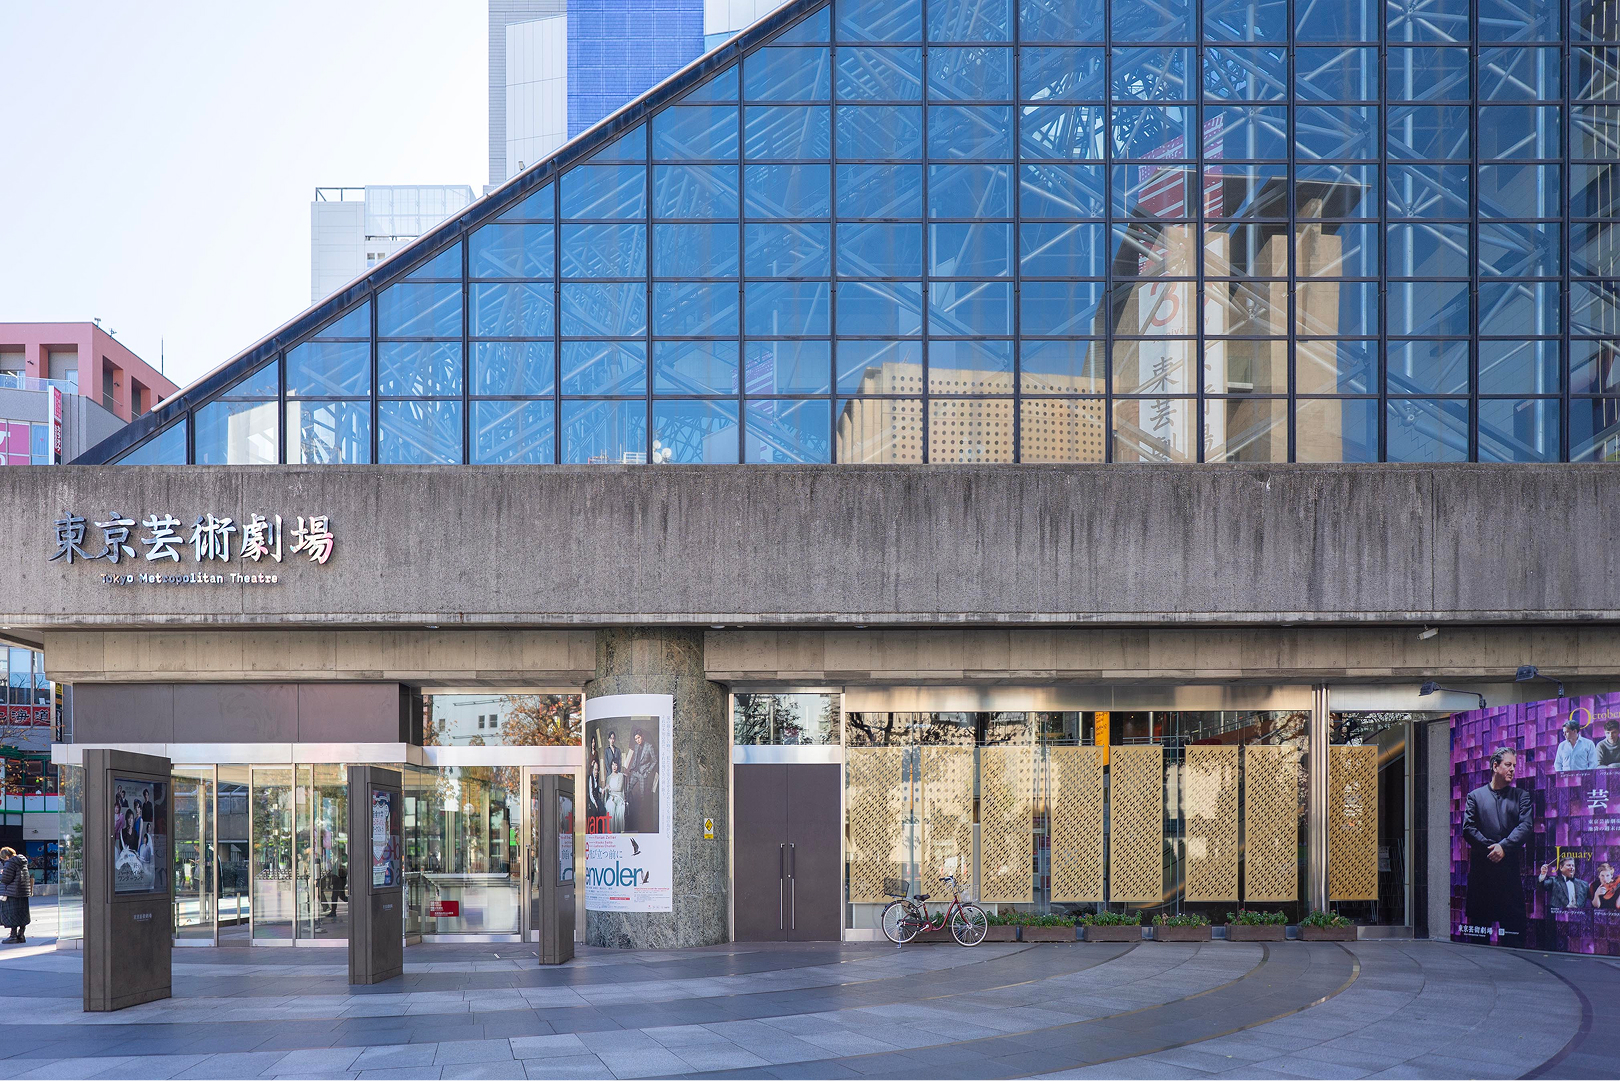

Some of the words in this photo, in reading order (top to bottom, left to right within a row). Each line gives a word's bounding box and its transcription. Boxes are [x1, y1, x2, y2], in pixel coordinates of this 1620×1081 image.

[48, 510, 335, 565] 東京芸術劇場
[101, 573, 134, 585] Tokyo
[139, 572, 224, 585] Metropolitan
[230, 572, 278, 584] Theatre
[1587, 788, 1609, 809] 芸
[1552, 846, 1593, 873] January
